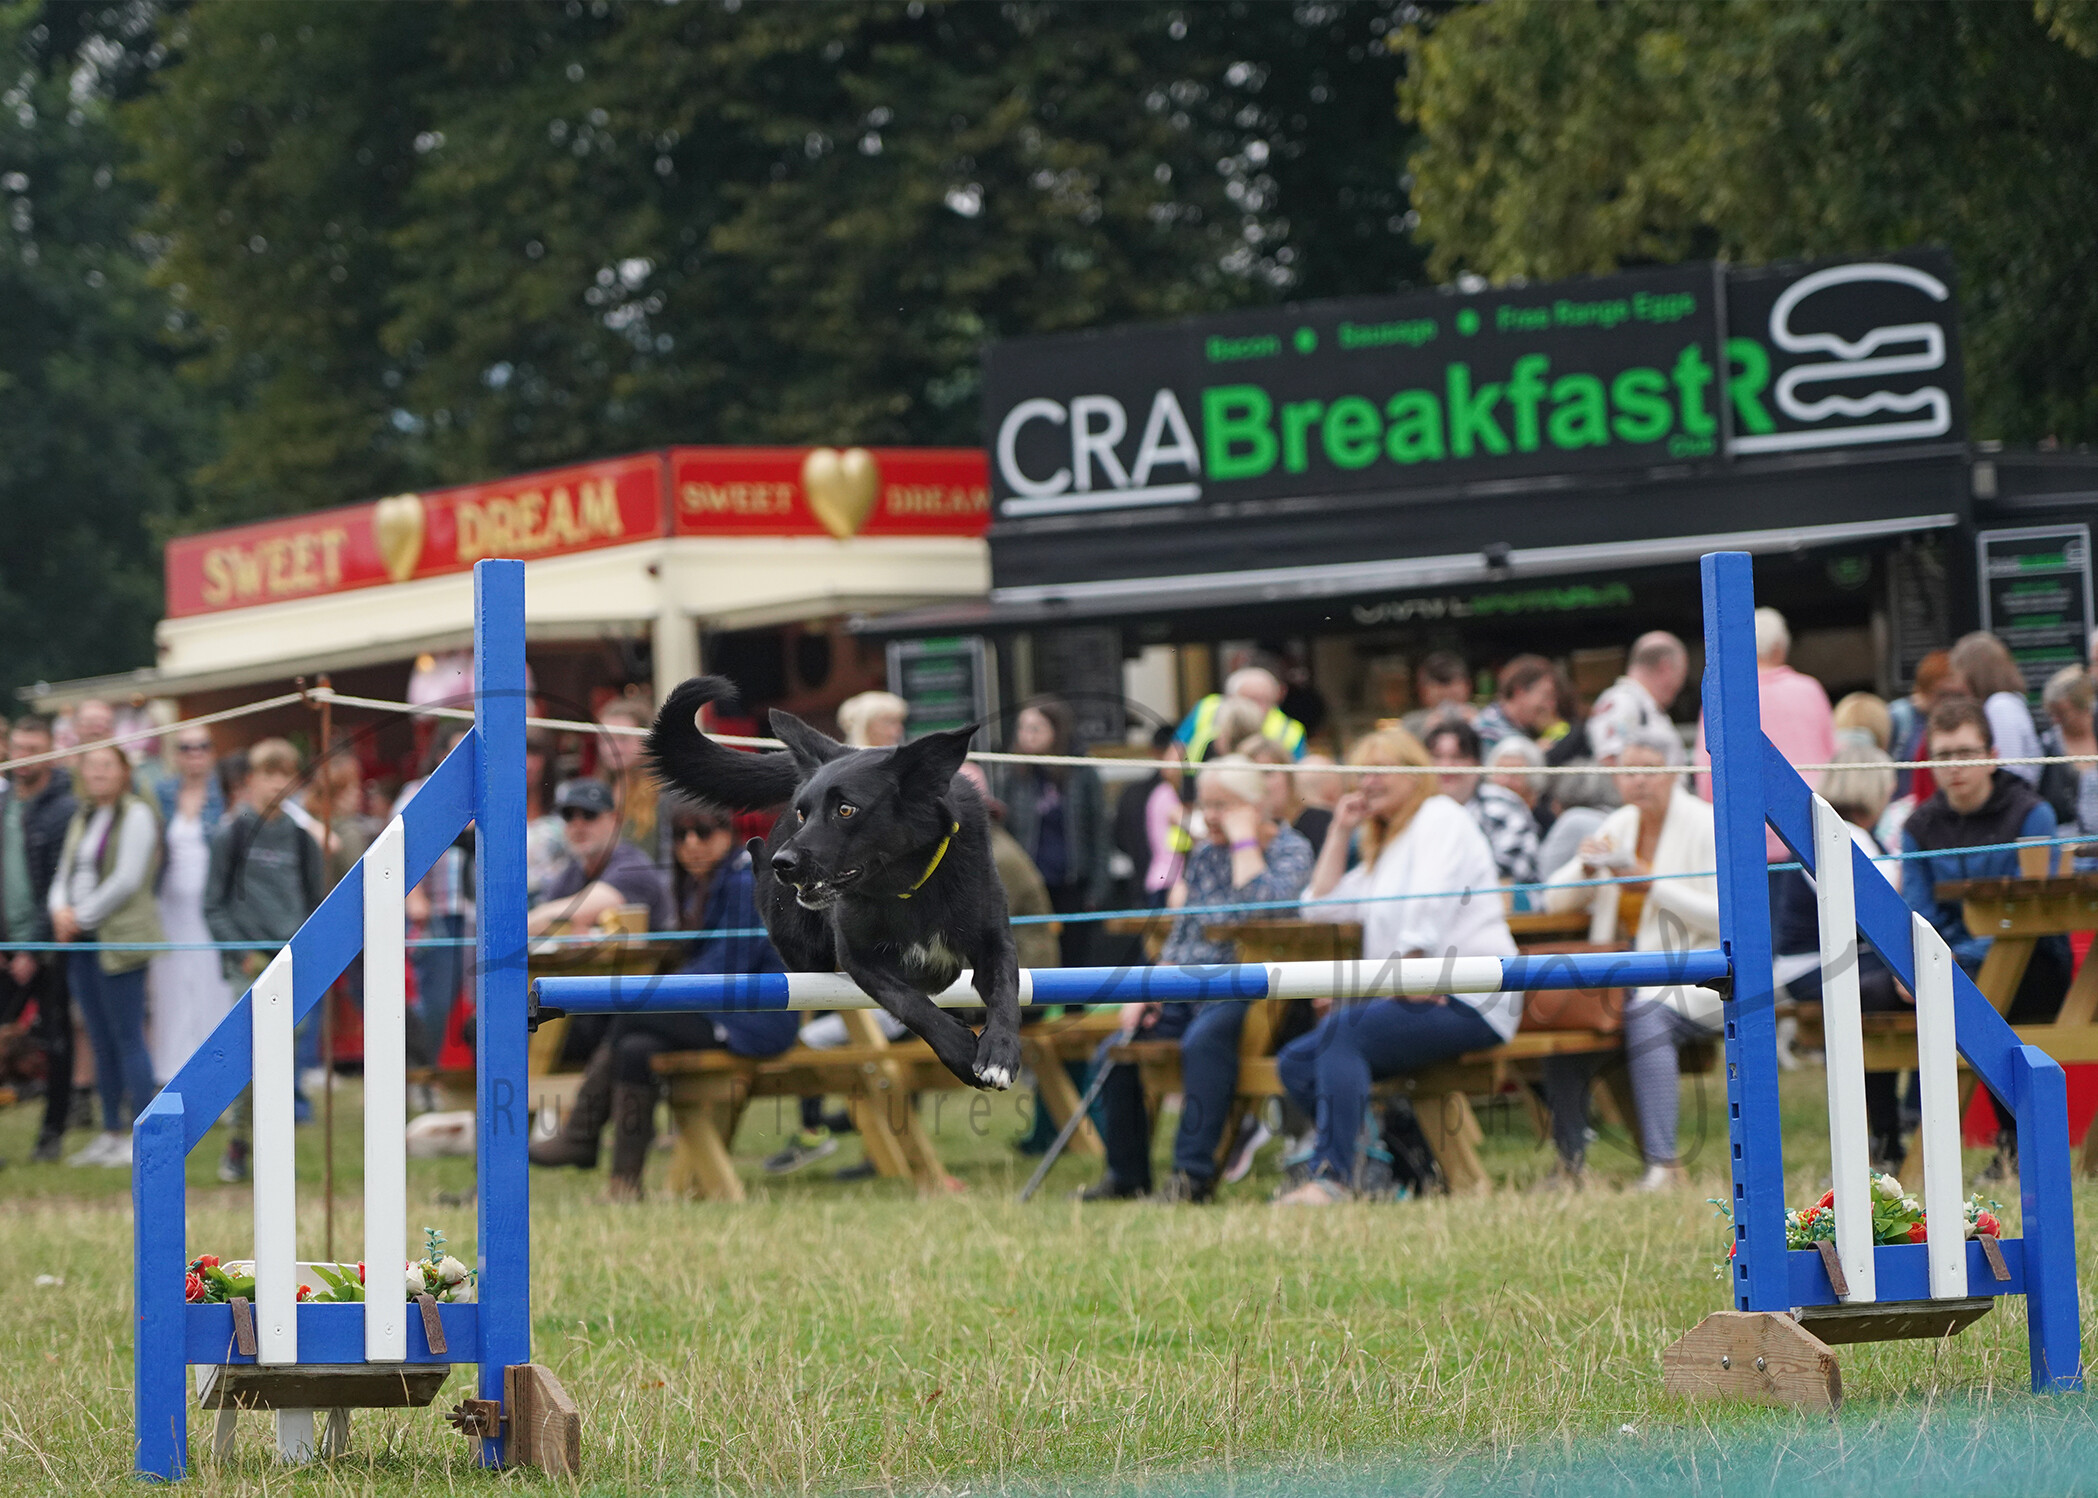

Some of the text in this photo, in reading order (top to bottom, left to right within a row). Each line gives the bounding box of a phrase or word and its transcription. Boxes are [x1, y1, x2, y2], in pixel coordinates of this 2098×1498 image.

[1205, 291, 1695, 362] Bacon Sausage Free Range Eggs
[997, 388, 1199, 498] CRA
[1202, 342, 1718, 481] Breakfast
[202, 477, 625, 602] SWEET DREAM
[680, 480, 796, 515] SWEET
